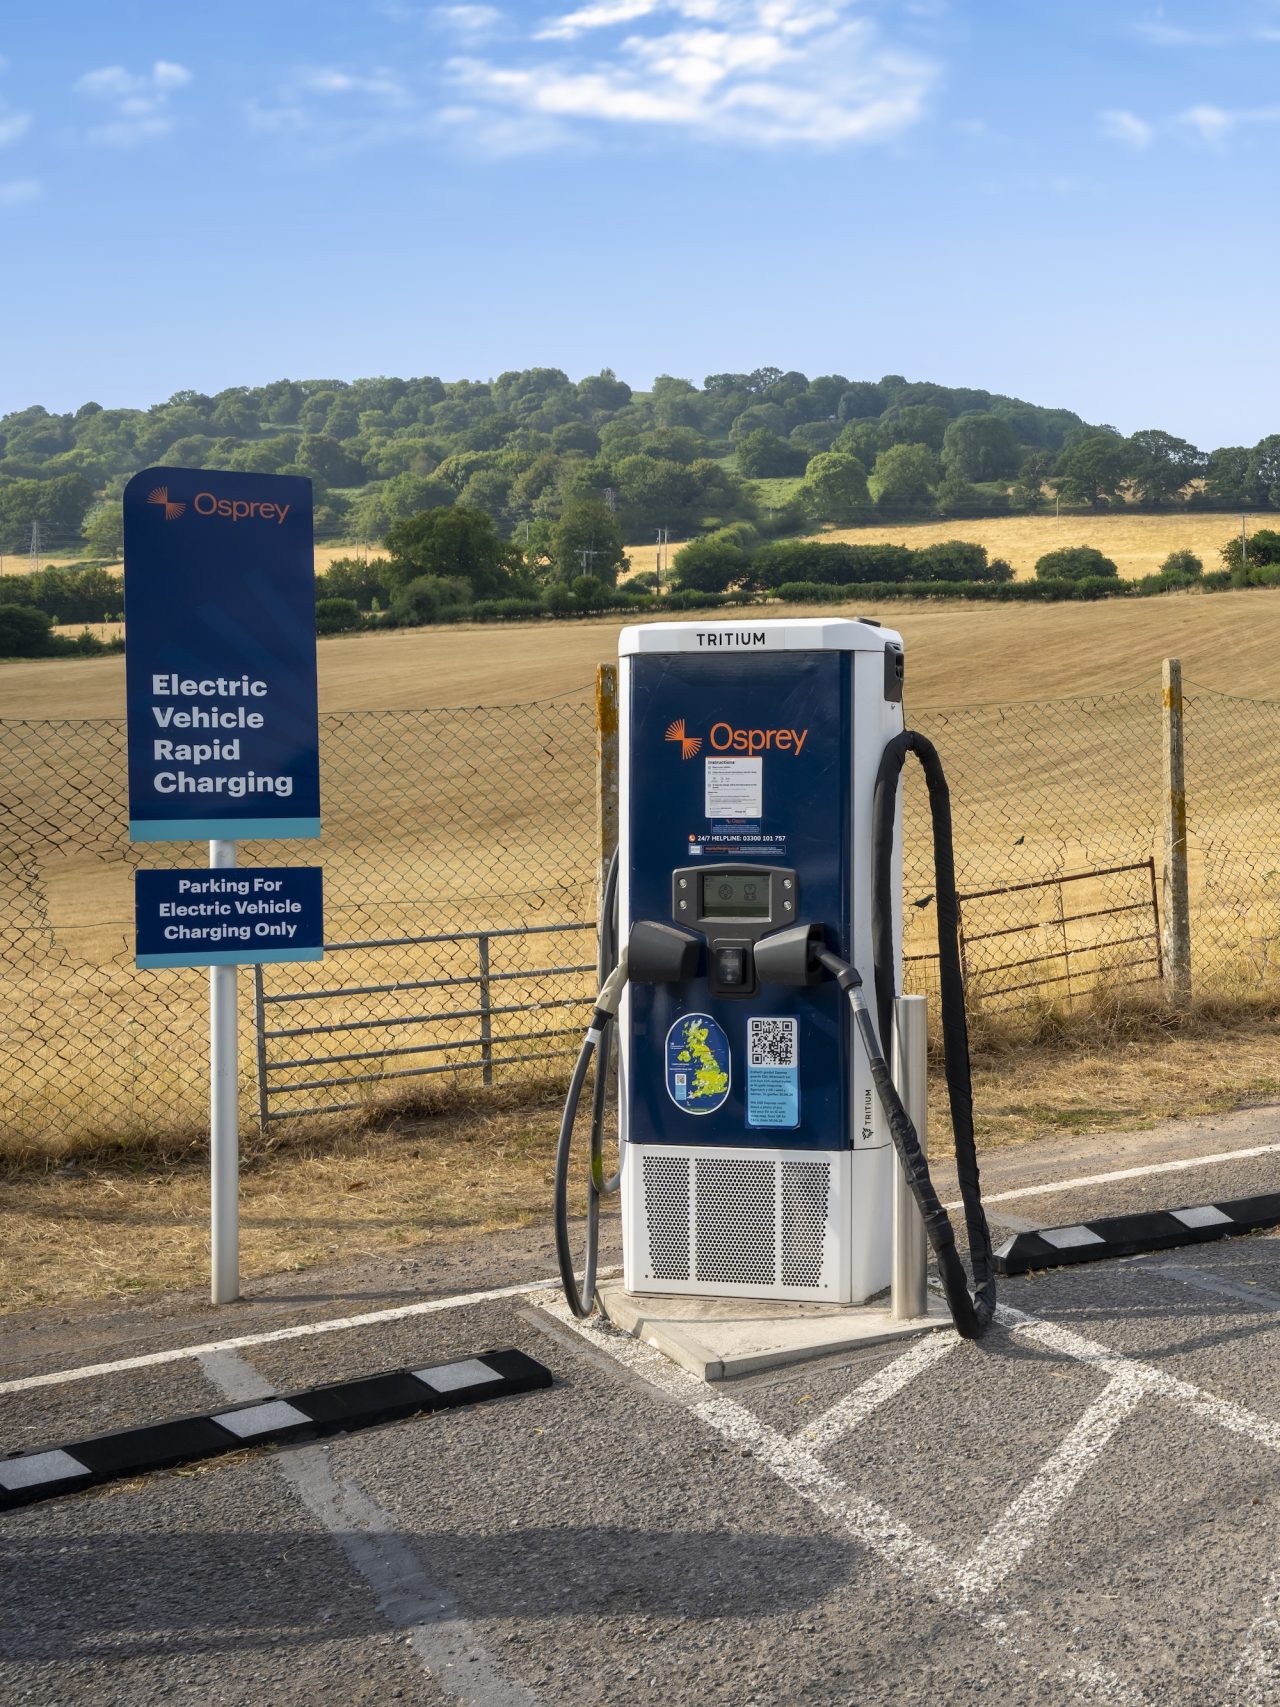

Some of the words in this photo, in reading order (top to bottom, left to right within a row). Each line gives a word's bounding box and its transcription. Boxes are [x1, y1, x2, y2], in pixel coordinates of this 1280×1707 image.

[194, 492, 290, 525] Osprey
[696, 632, 766, 647] TRITIUM
[152, 673, 268, 697] Electric
[152, 706, 265, 729] Vehicle
[709, 722, 808, 756] Osprey
[153, 738, 241, 766] Rapid
[153, 770, 293, 798] Charging
[178, 878, 250, 896] Parking
[253, 877, 283, 892] For
[159, 901, 231, 917] Electric
[234, 899, 302, 915] Vehicle
[164, 923, 251, 941] Charging
[254, 921, 298, 938] Only
[864, 1089, 872, 1125] TRITIUM
